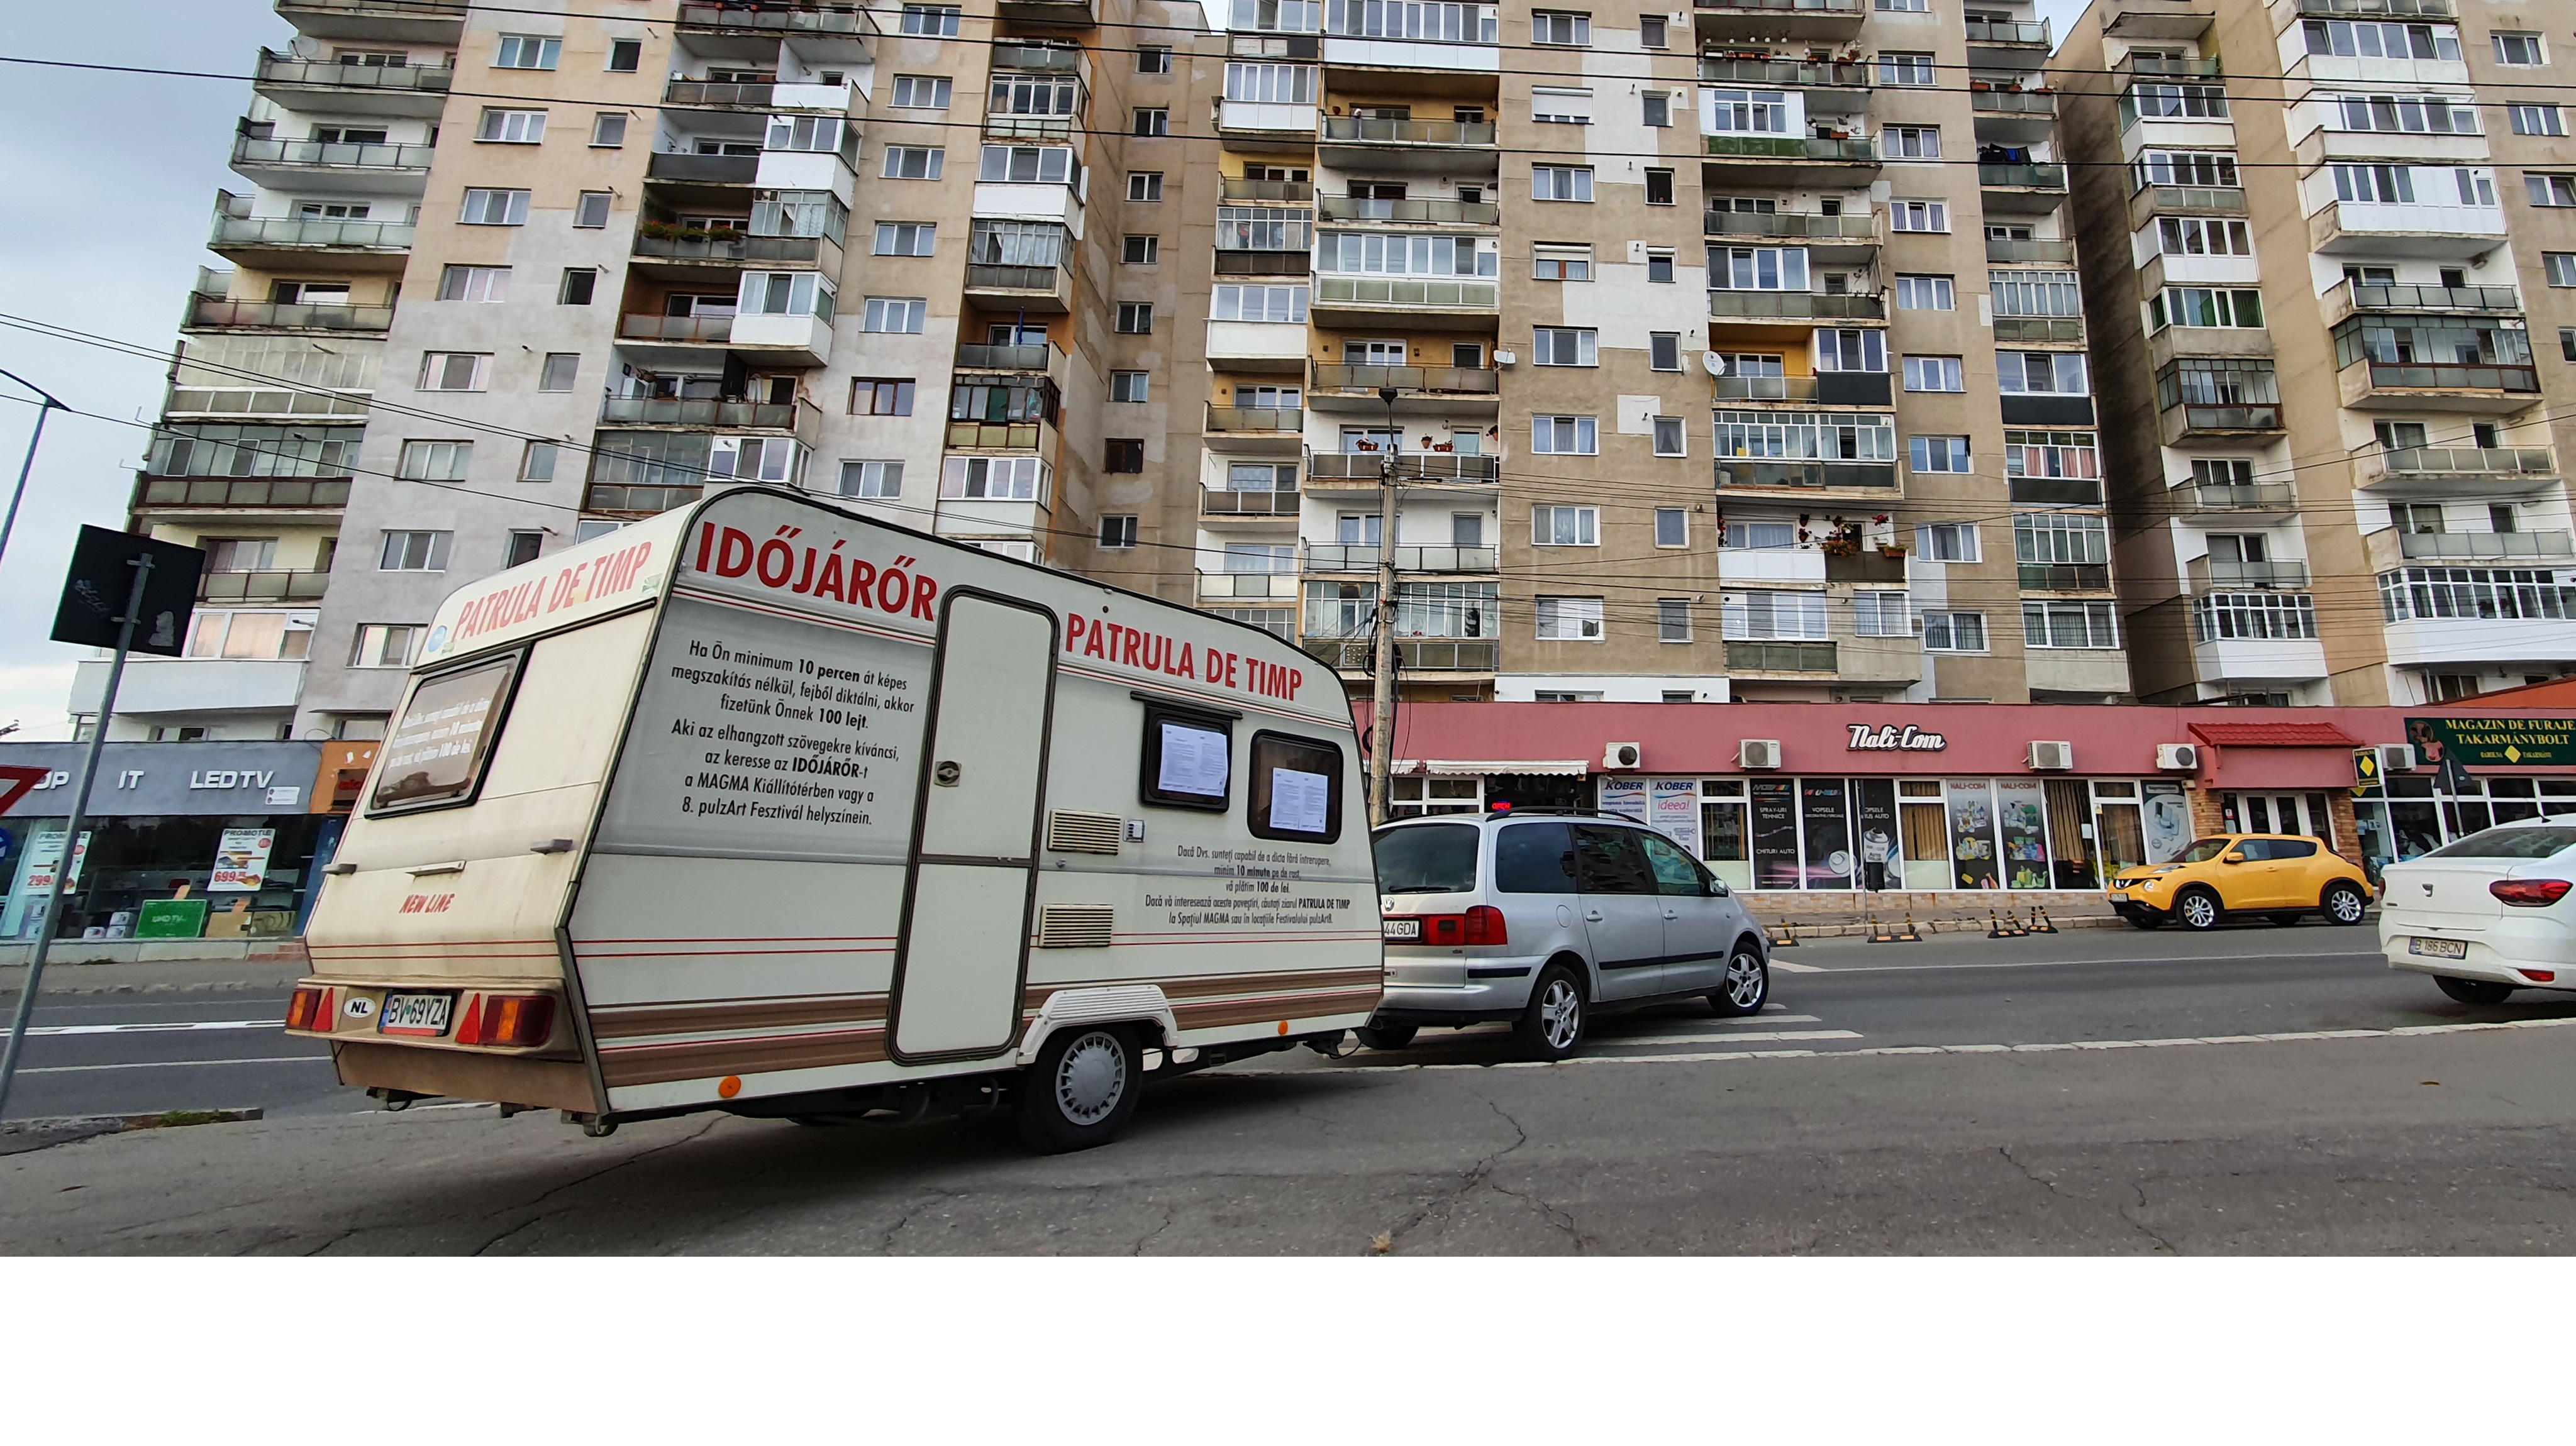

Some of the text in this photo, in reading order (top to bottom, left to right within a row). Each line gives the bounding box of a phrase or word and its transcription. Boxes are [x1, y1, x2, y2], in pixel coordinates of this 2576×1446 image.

[695, 521, 937, 622] IDŐJÁRŐR
[451, 541, 652, 643] PATRULA DE TIMP
[689, 640, 907, 691] Ha Ön minimum 10 percen át képes
[1065, 612, 1302, 701] PATRULA DE TIMP
[671, 666, 914, 712] megszakítás nélkül, fejből diktálni, akkor
[720, 693, 869, 731] fizetünk Önnek 100 lejt.
[2445, 720, 2575, 731] MAGAZIN DE FURAJE
[671, 718, 899, 762] Aki az elhangzott szövegekre kíváncsi,
[1847, 725, 1946, 749] Nali-Com
[2456, 732, 2570, 744] TAKARMÁNYBOLT
[705, 749, 868, 778] az keresse az IDŐJÁRŐR-t
[118, 770, 145, 790] IT
[685, 771, 874, 804] a MAGMA Kiállítótérben vagy a
[682, 796, 872, 825] 8. pulzArt Fesztivál helyszínein.
[1657, 800, 1690, 810] ideea!
[1177, 845, 1194, 858] Dacă
[1196, 846, 1210, 859] Dvs.
[1234, 849, 1257, 863] capabil
[1258, 851, 1265, 861] de
[1266, 854, 1270, 862] a
[1272, 851, 1285, 863] dicta
[1287, 852, 1298, 864] fără
[214, 871, 236, 882] 699
[1214, 864, 1235, 875] minim
[1236, 865, 1245, 876] 10
[1246, 866, 1270, 877] minute
[1272, 870, 1279, 880] pe
[1280, 867, 1287, 878] de
[1226, 880, 1290, 893] vă plătim 100 de lei.
[399, 893, 455, 913] NEW LINE
[1145, 895, 1162, 907] Dacă
[1165, 895, 1172, 907] vă
[1174, 896, 1211, 907] interesează
[1213, 897, 1231, 907] aceste
[1282, 898, 1297, 908] ziarul
[1298, 898, 1325, 908] PATRULA
[1327, 899, 1334, 909] DE
[1336, 899, 1350, 909] TIMP
[1169, 912, 1175, 924] la
[1203, 913, 1230, 924] MAGMA
[1231, 915, 1241, 924] sau
[1275, 913, 1308, 924] Festivalului
[350, 1001, 368, 1014] NL
